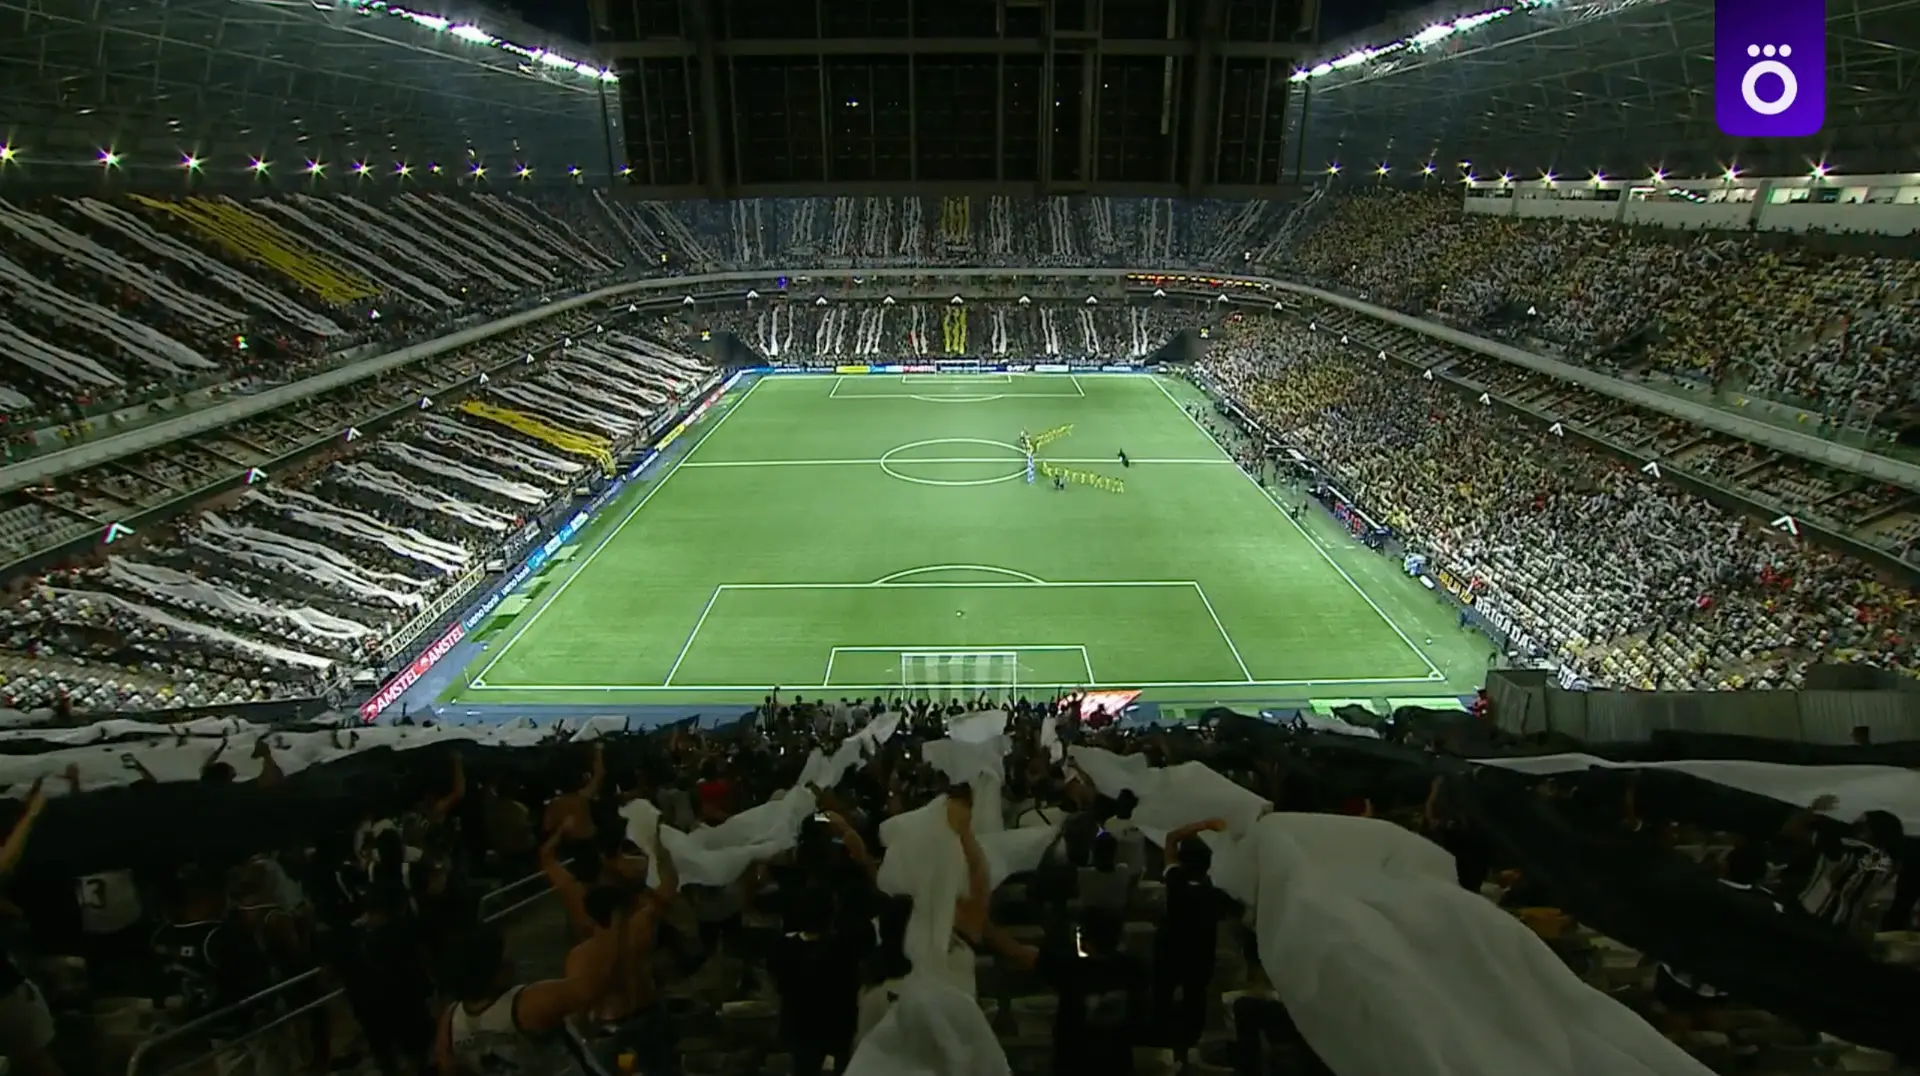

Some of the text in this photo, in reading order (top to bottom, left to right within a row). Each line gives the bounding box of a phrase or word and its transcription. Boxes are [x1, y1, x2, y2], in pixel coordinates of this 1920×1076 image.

[466, 594, 500, 628] ueno bank
[1474, 595, 1529, 650] BRIGADA
[427, 626, 466, 665] AMSTEL
[376, 668, 421, 713] AMSTEL
